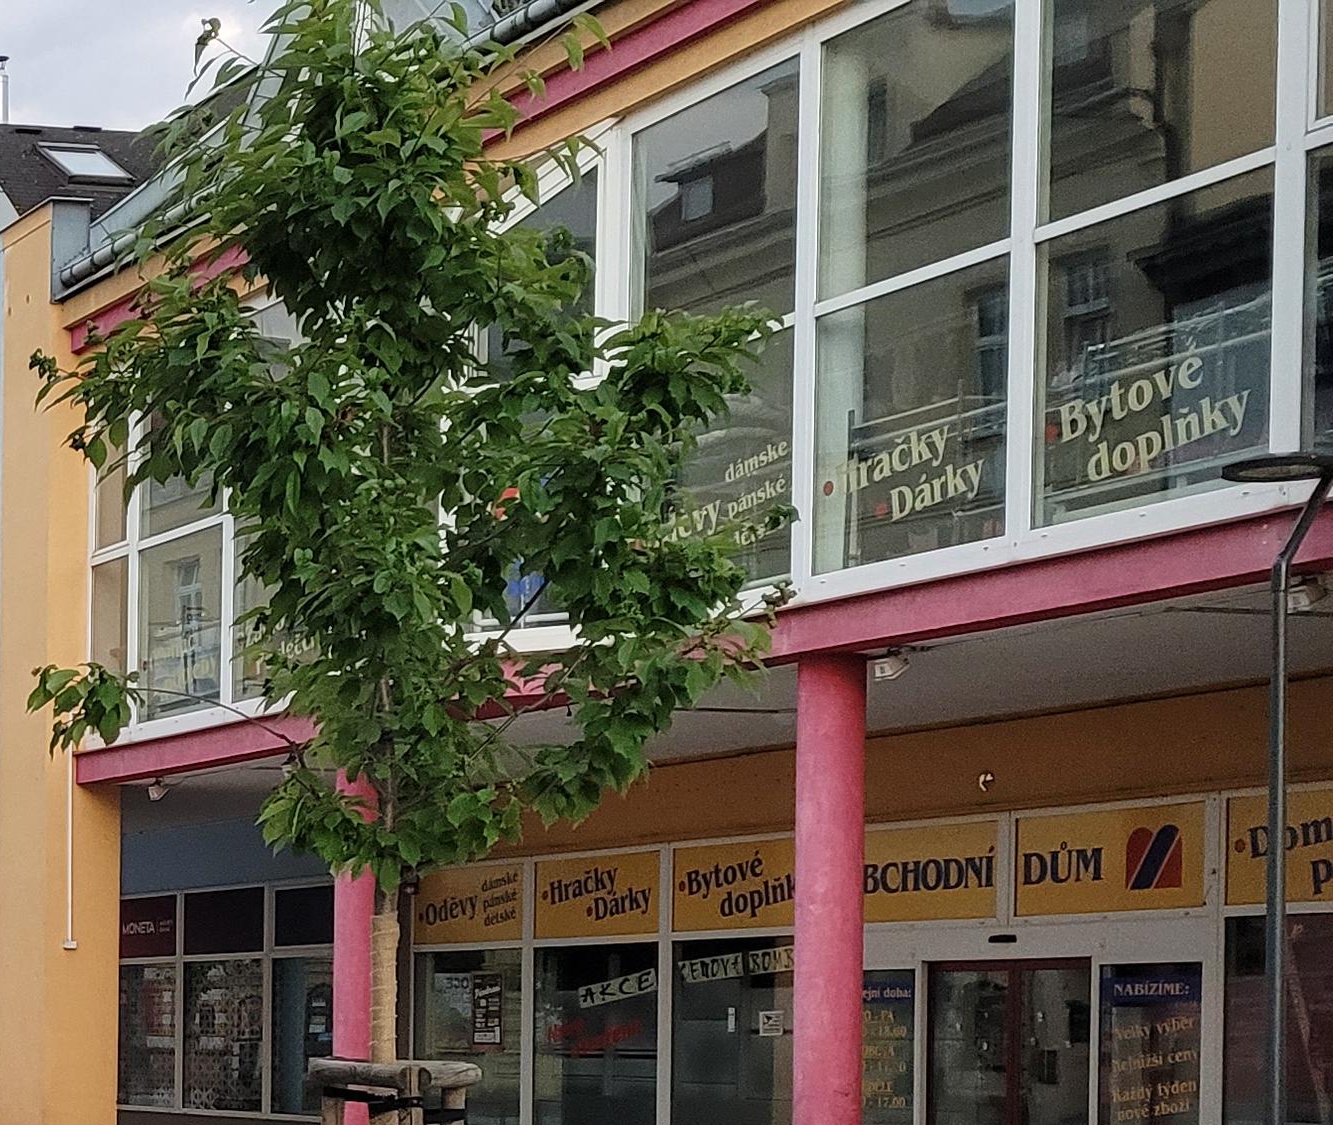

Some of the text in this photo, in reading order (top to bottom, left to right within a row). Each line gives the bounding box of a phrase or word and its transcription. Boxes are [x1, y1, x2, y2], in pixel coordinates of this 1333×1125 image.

[1059, 342, 1204, 443] Bytové
[1086, 388, 1252, 482] doplňky
[727, 474, 787, 520] pánské
[889, 458, 986, 522] Dárky
[549, 867, 618, 905] Hračky
[687, 850, 763, 899] Bytové
[864, 841, 1103, 894] BCHODNÍ DŮM
[425, 896, 479, 926] Oděvy
[592, 887, 652, 921] Dárky
[719, 873, 795, 918] doplňk
[749, 950, 794, 973] BOMB
[580, 970, 655, 1005] AKCE
[1113, 981, 1190, 997] NABÍZÍME:
[1157, 1080, 1197, 1099] týden
